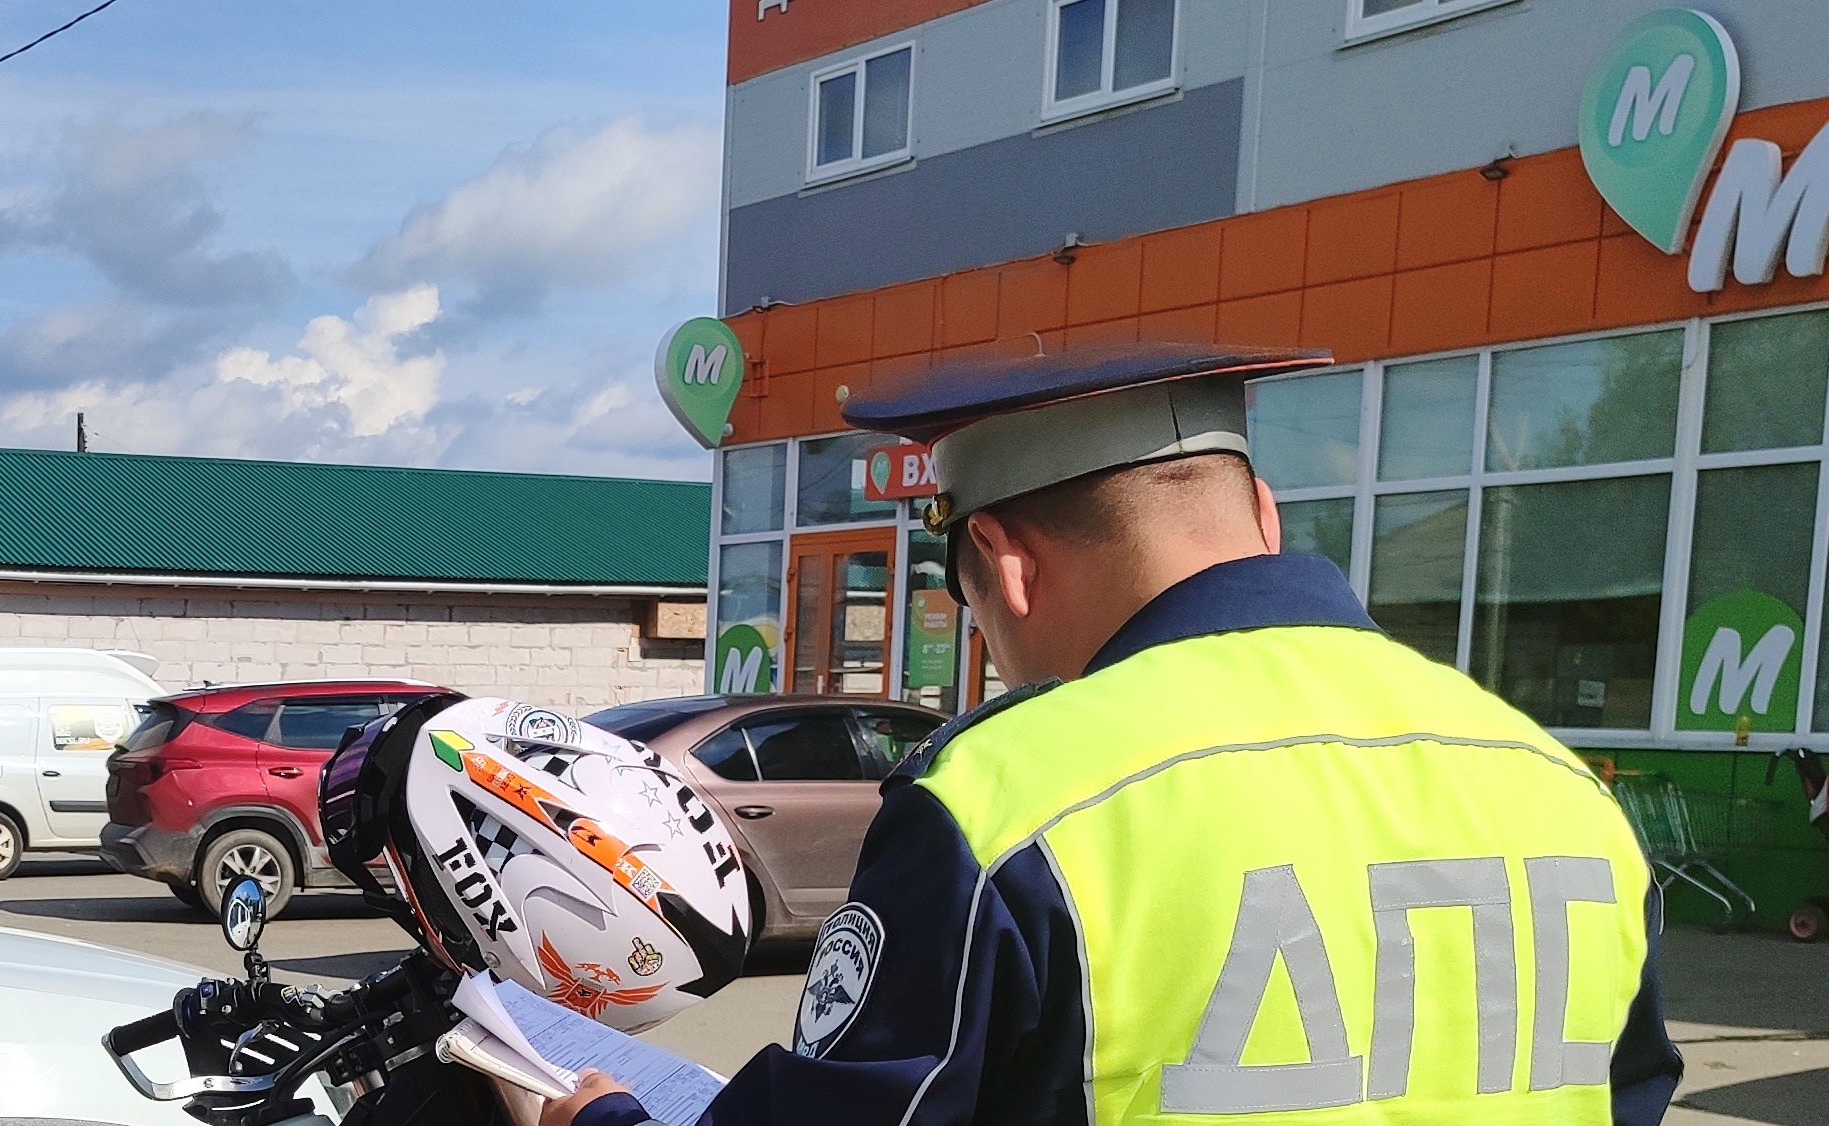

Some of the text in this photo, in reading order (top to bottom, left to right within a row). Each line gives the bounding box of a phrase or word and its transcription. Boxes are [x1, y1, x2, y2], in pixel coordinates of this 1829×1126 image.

[431, 836, 519, 942] FOX
[815, 937, 865, 982] РОССИЯ
[821, 912, 877, 951] ПОЛИЦИЯ
[1160, 856, 1617, 1115] ДПС
